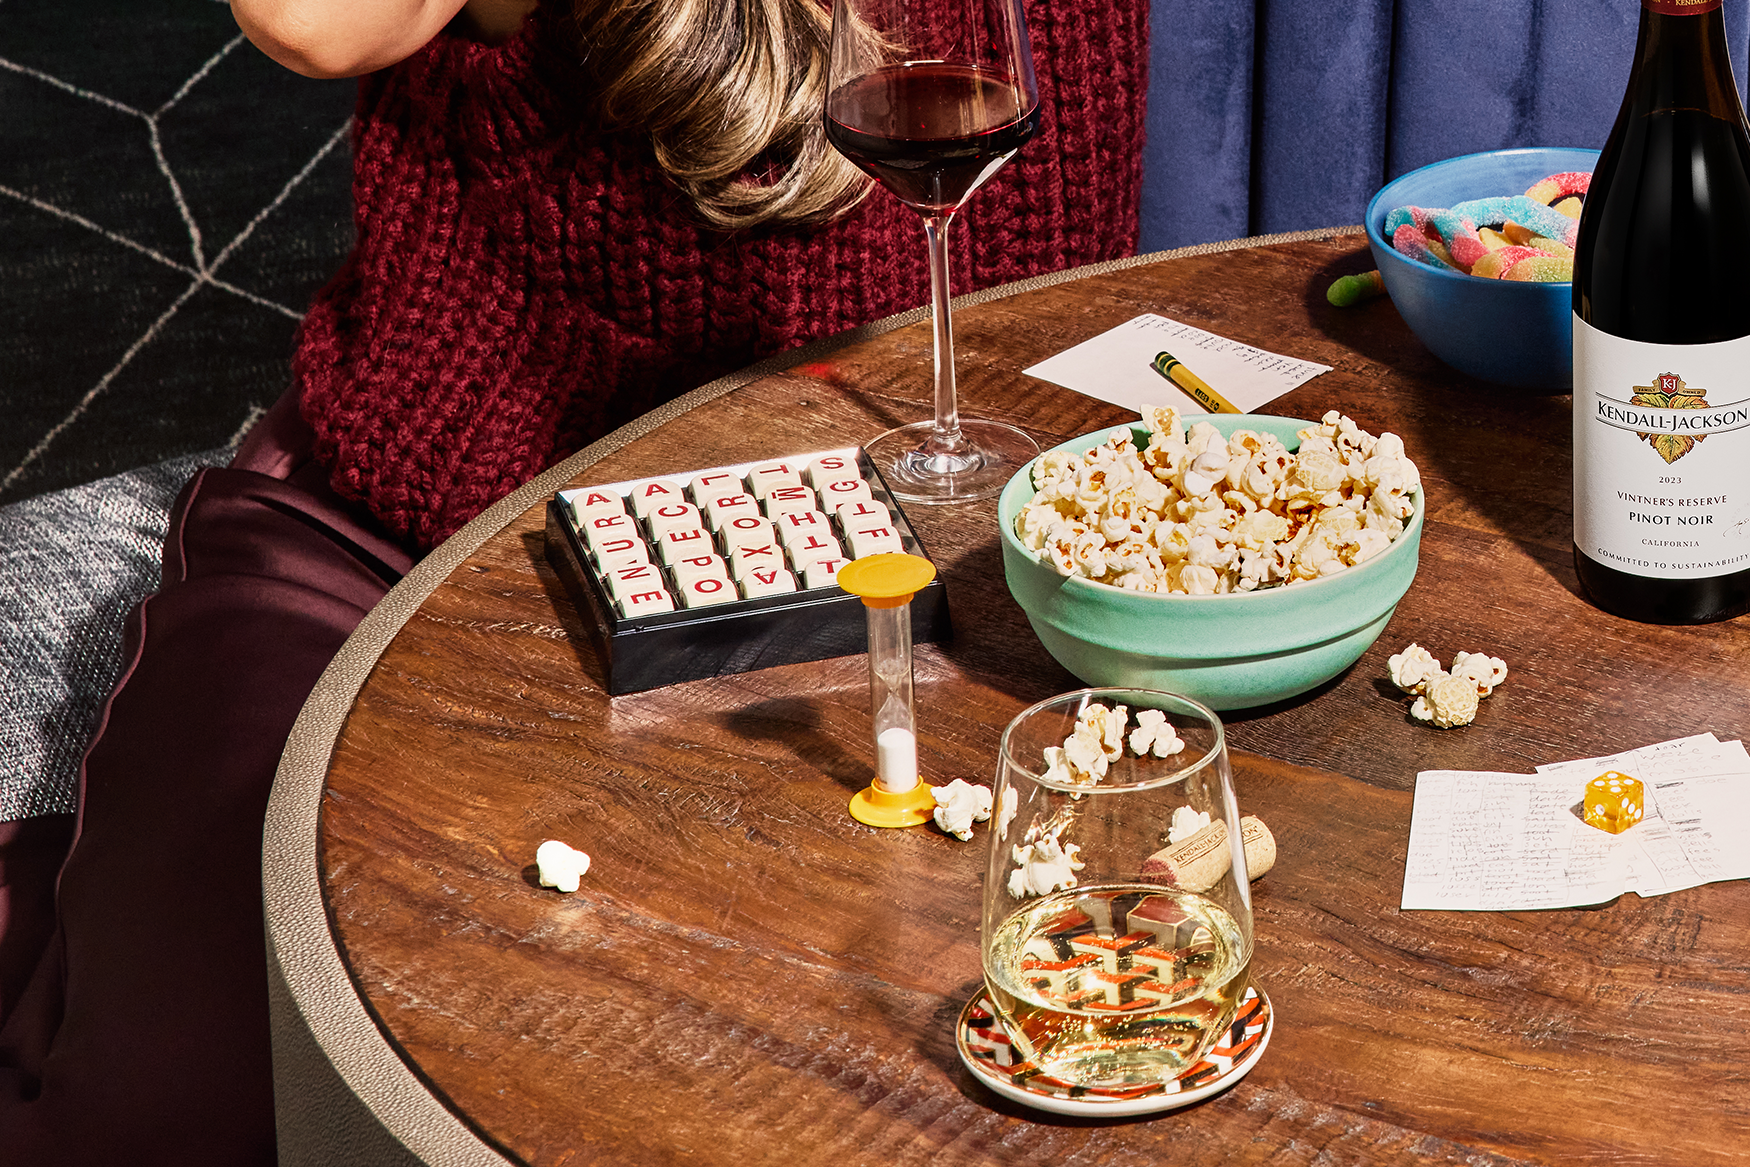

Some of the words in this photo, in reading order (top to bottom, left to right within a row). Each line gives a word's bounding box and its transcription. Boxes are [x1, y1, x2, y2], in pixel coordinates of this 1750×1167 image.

[1662, 378, 1677, 391] K-J
[1598, 400, 1748, 431] KENDALL-JACKSON
[586, 492, 611, 506] A
[645, 483, 670, 497] A
[759, 464, 789, 474] T
[820, 457, 844, 469] S
[1658, 476, 1682, 484] 2023
[594, 515, 625, 528] R
[658, 505, 688, 517] C
[717, 494, 747, 508] R
[830, 480, 859, 492] G
[1617, 491, 1674, 507] VINTNER'S
[1678, 494, 1727, 507] RESERVE
[602, 539, 634, 553] U
[670, 530, 701, 542] E
[733, 517, 760, 528] O
[853, 503, 876, 515] T
[1629, 511, 1671, 526] PINOT
[1677, 514, 1714, 526] NOIR
[682, 555, 712, 567] P
[741, 545, 773, 558] X
[804, 535, 828, 550] T
[858, 527, 890, 538] F
[1641, 538, 1700, 547] CALIFORNIA
[1597, 547, 1650, 567] COMMITTED
[1671, 552, 1750, 570] SUSTAINABILITY
[630, 590, 663, 604] E
[694, 579, 723, 593] O
[753, 570, 777, 584] A
[817, 559, 841, 573] T
